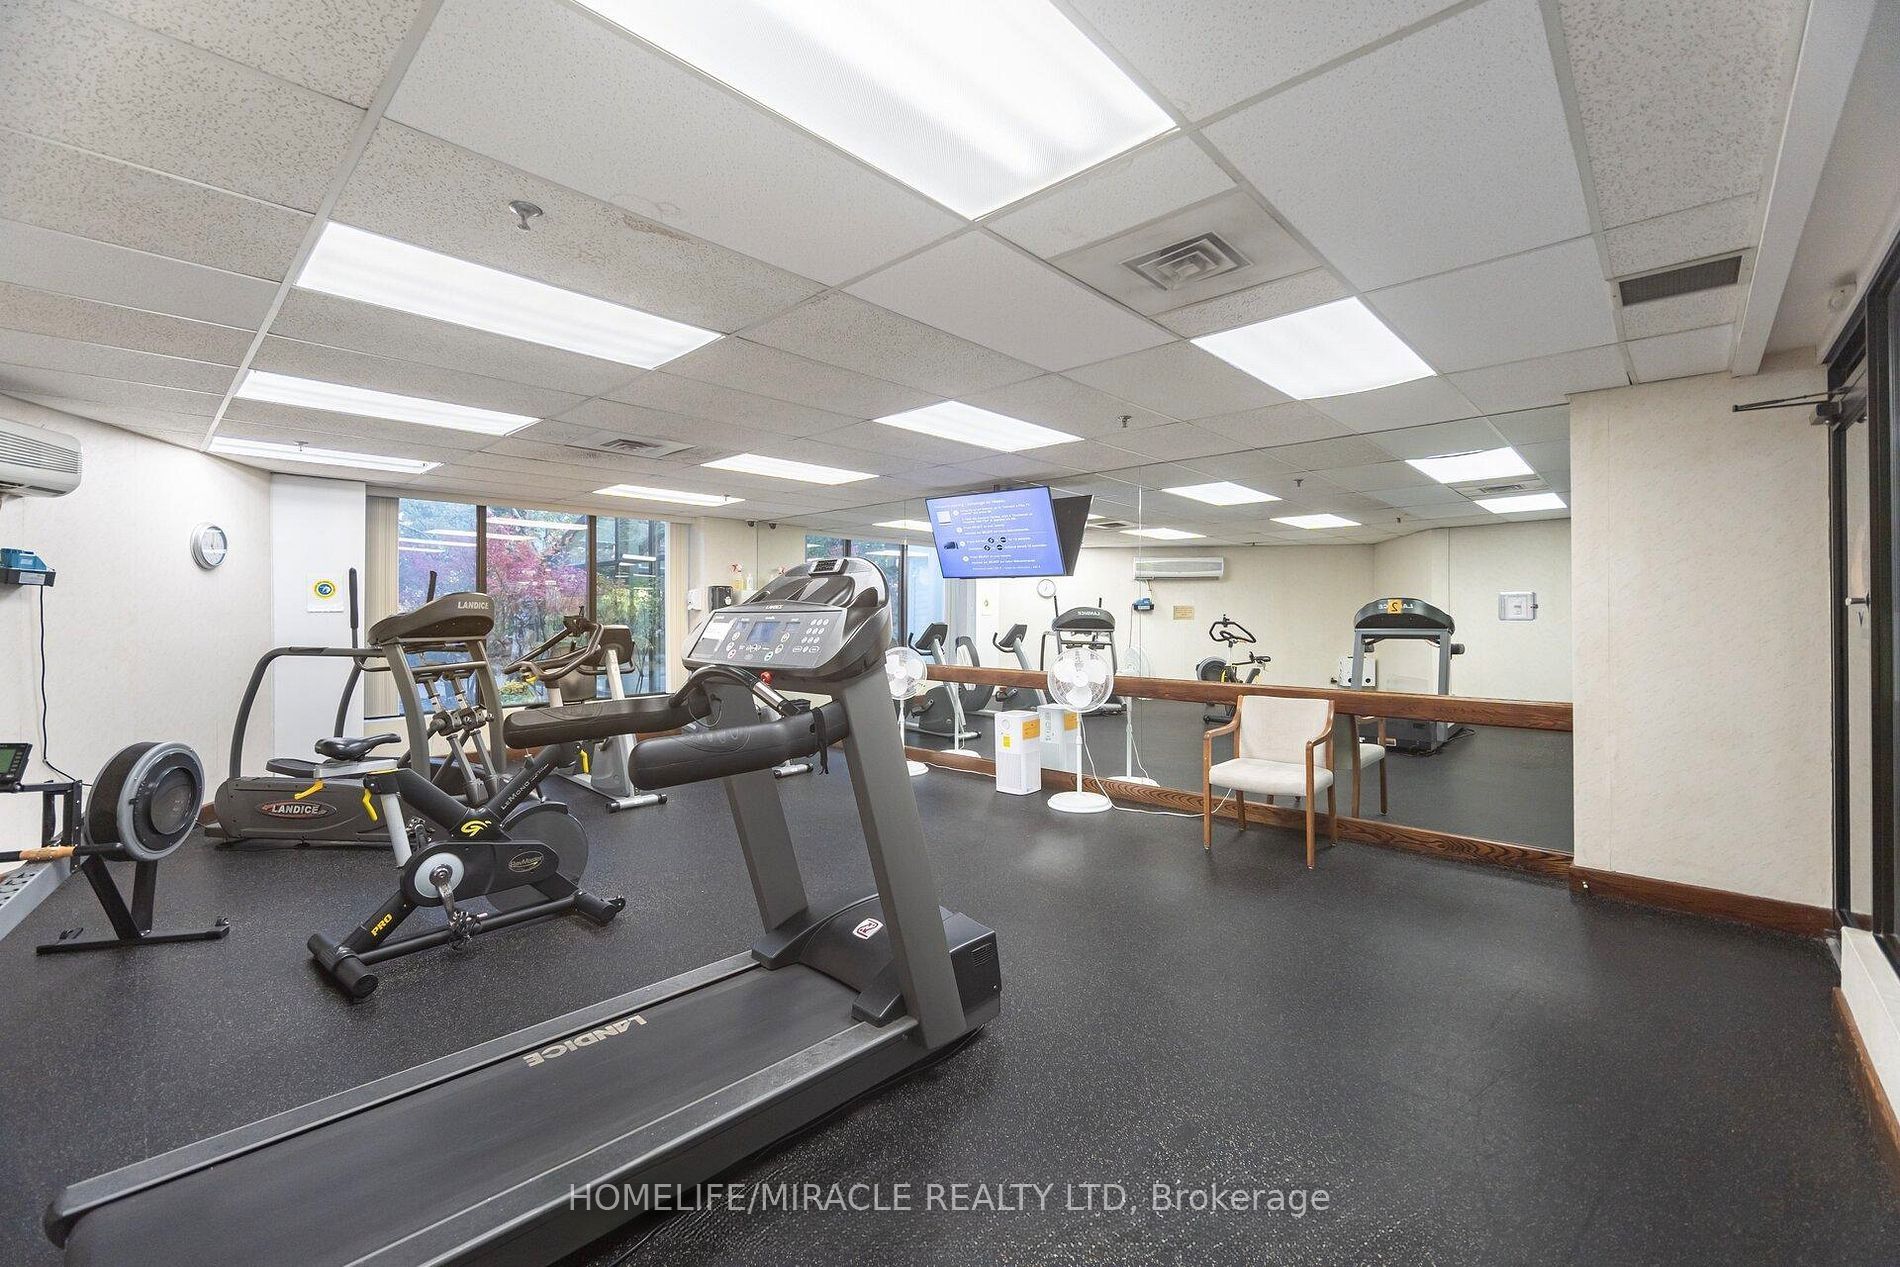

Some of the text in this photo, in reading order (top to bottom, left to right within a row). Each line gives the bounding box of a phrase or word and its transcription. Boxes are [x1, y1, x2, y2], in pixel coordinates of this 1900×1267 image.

[457, 601, 489, 610] LANDICE
[271, 804, 320, 814] LANDICE
[370, 913, 393, 937] PRO
[522, 1014, 648, 1068] LANDICE
